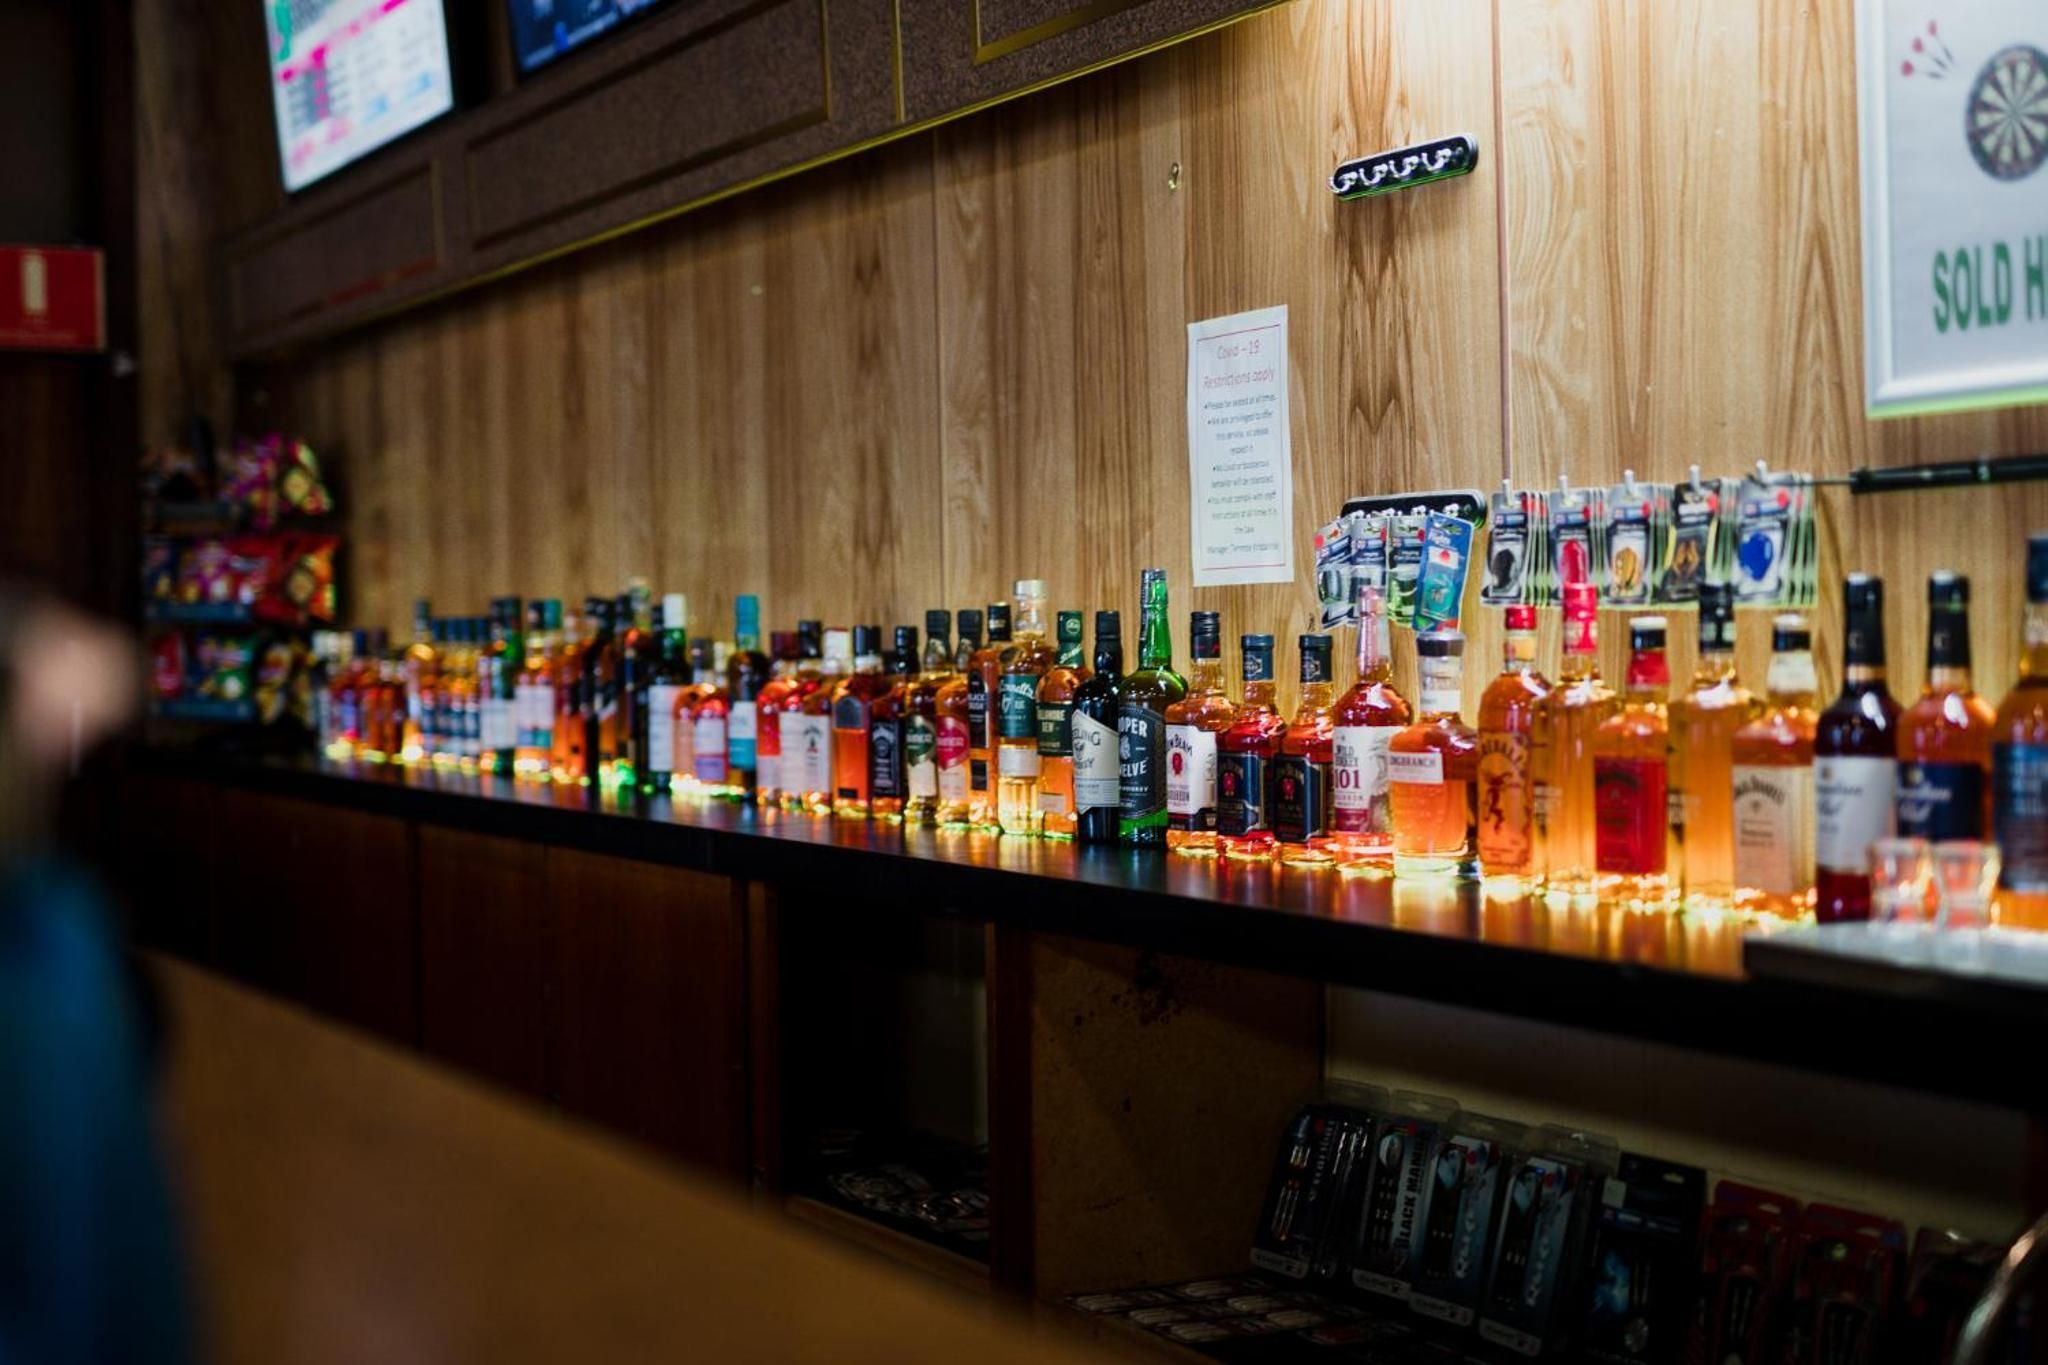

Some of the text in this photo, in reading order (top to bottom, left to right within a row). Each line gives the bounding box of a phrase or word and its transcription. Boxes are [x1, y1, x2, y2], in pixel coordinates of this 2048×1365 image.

[1933, 235, 2048, 334] SOLD H
[1249, 338, 1262, 355] 19
[1119, 716, 1148, 737] OPER
[1119, 758, 1149, 778] ELVE
